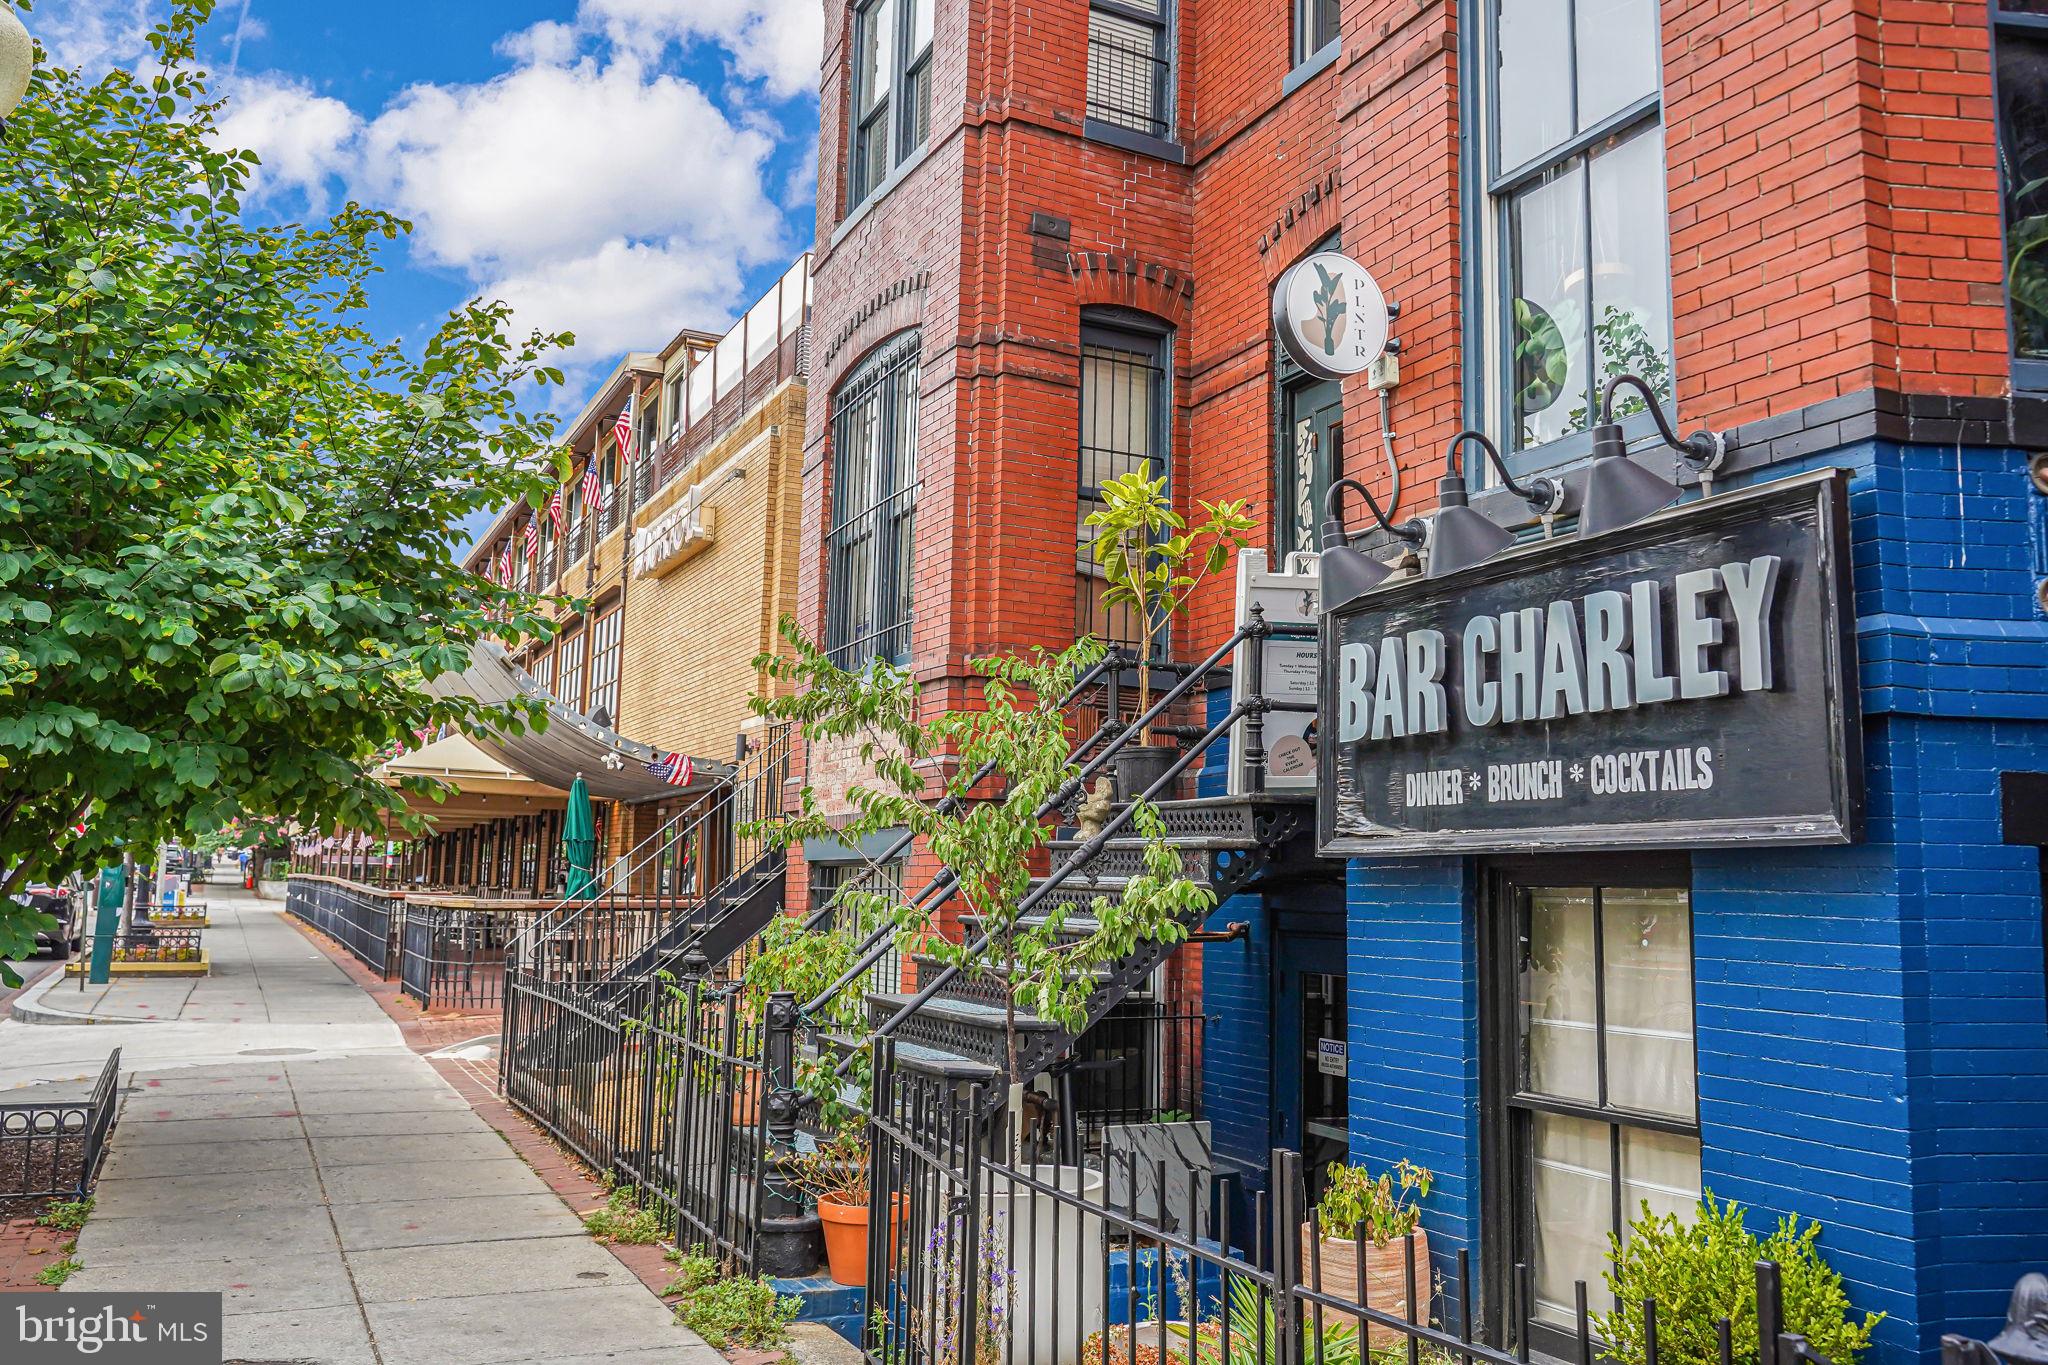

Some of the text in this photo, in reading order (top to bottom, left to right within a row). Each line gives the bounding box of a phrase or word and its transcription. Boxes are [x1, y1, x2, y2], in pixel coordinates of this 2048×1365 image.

[1354, 279, 1366, 357] PLNTR
[1339, 555, 1781, 743] BAR CHARLEY
[1282, 762, 1304, 773] CALENDAR
[1405, 746, 1713, 807] DINNER BRUNCH COCKTAILS
[1320, 1042, 1344, 1054] NOTICE
